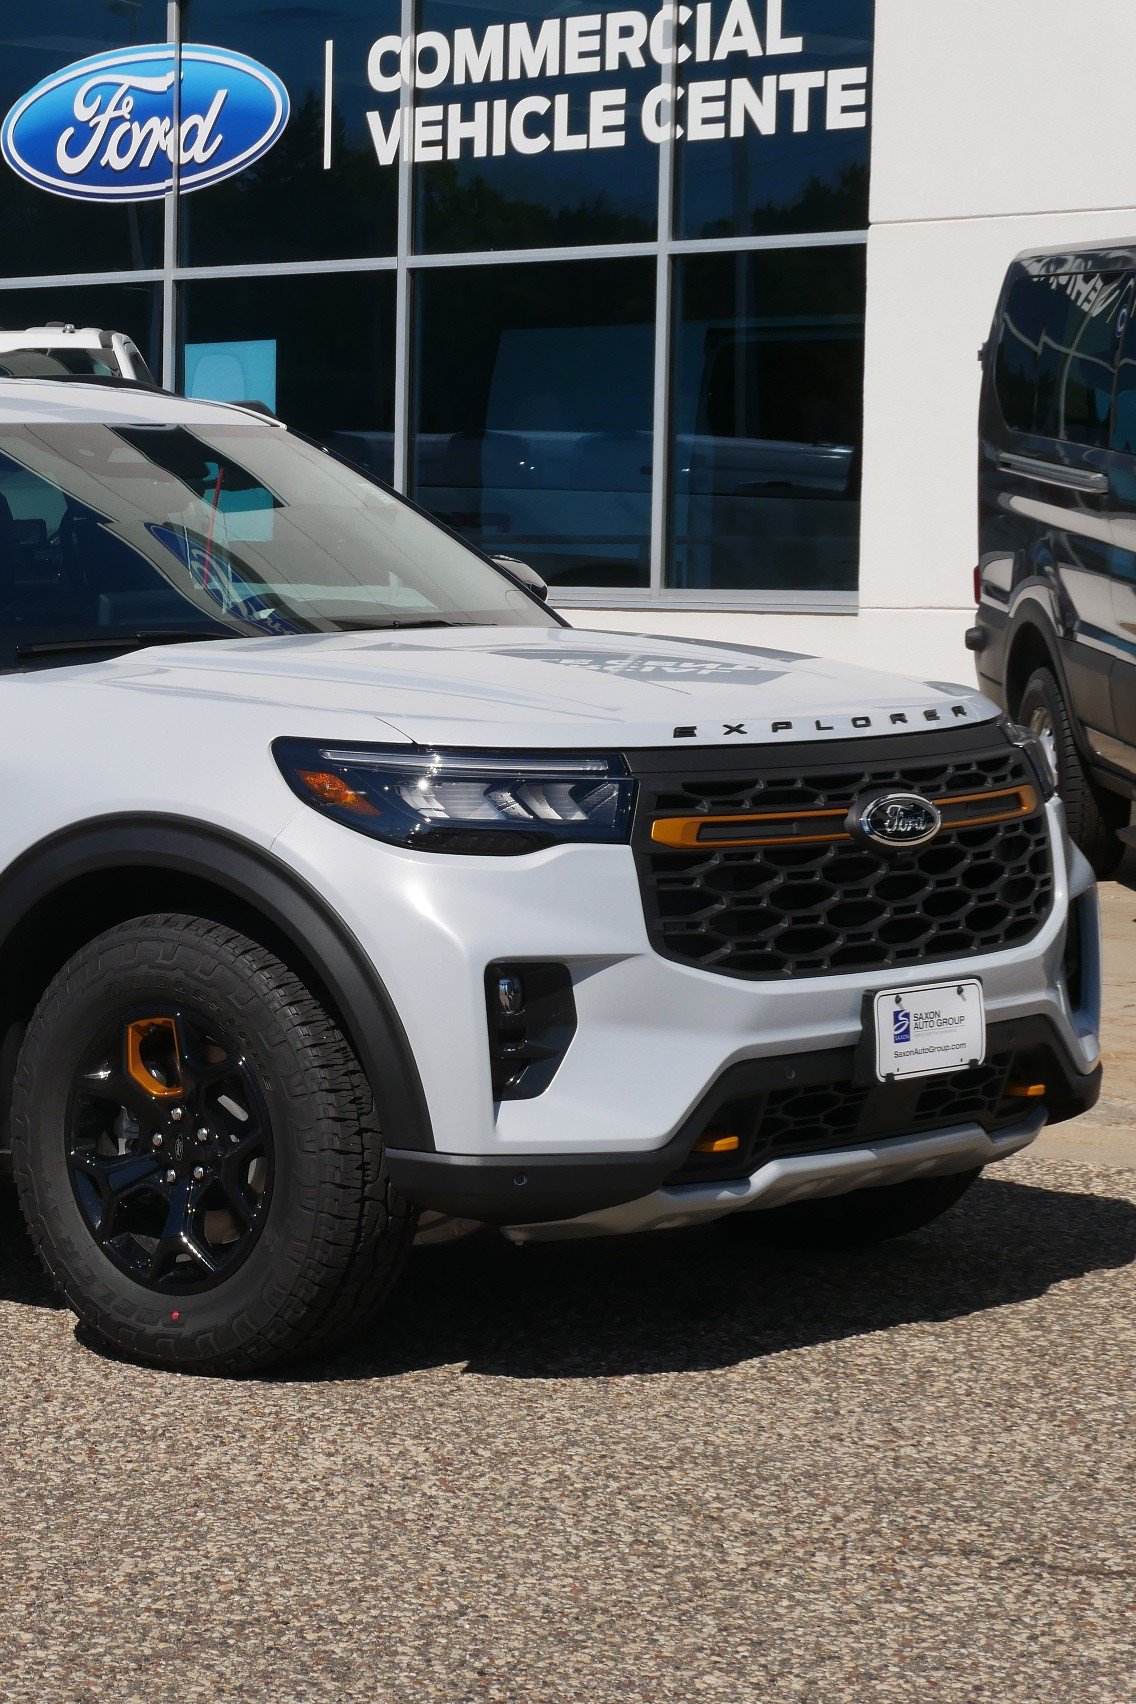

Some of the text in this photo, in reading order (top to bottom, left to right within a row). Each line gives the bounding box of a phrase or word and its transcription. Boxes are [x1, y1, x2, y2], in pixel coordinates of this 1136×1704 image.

[367, 0, 803, 92] COMMERCIAL
[57, 70, 225, 173] Ford
[366, 66, 868, 166] VEHICLE CENTE
[672, 705, 968, 738] EXPLORER
[883, 804, 930, 833] Ford
[913, 1011, 940, 1021] SAXON
[913, 1016, 965, 1030] AUTO GROUP
[894, 1043, 966, 1058] SaxonAutoGroup.com
